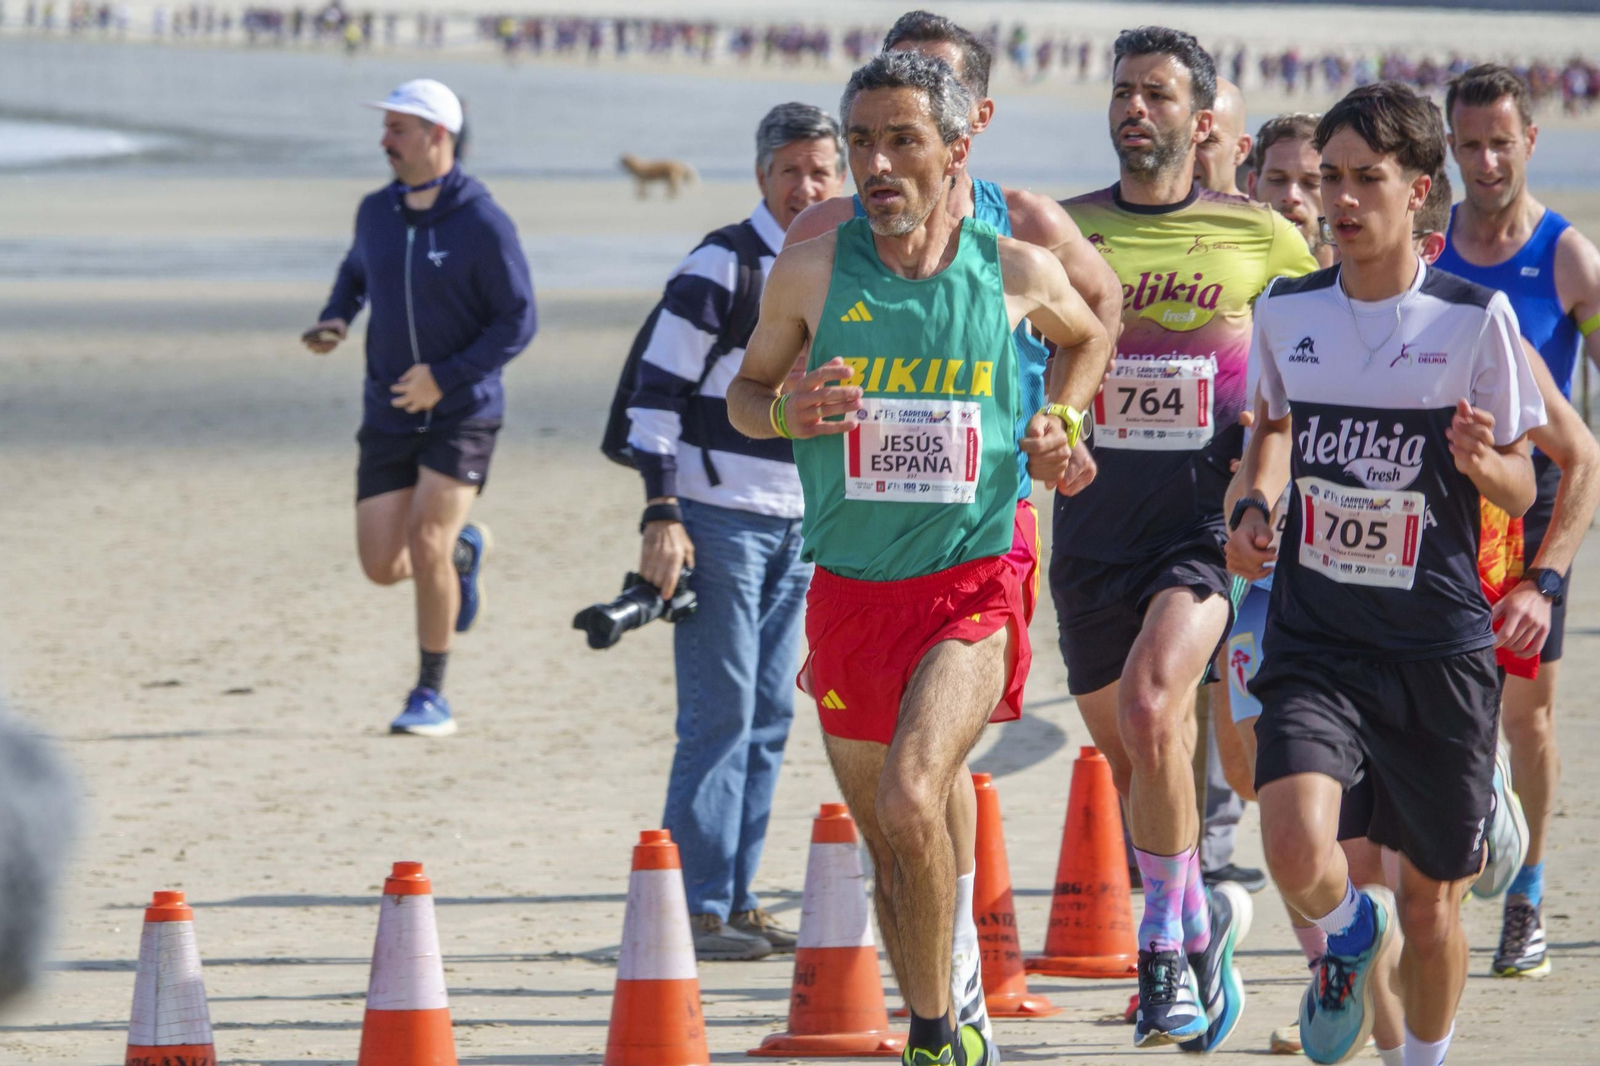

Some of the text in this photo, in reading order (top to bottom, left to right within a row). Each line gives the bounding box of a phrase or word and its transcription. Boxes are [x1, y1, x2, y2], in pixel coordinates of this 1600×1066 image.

[1122, 272, 1224, 311] elikia
[1162, 309, 1197, 322] fresh
[840, 357, 994, 397] BIKILA
[1117, 387, 1184, 416] 764
[880, 432, 944, 453] JESÚS
[1299, 415, 1426, 466] delikia
[871, 451, 953, 474] ESPAÑA
[1366, 467, 1400, 483] fresh
[1325, 511, 1388, 551] 705
